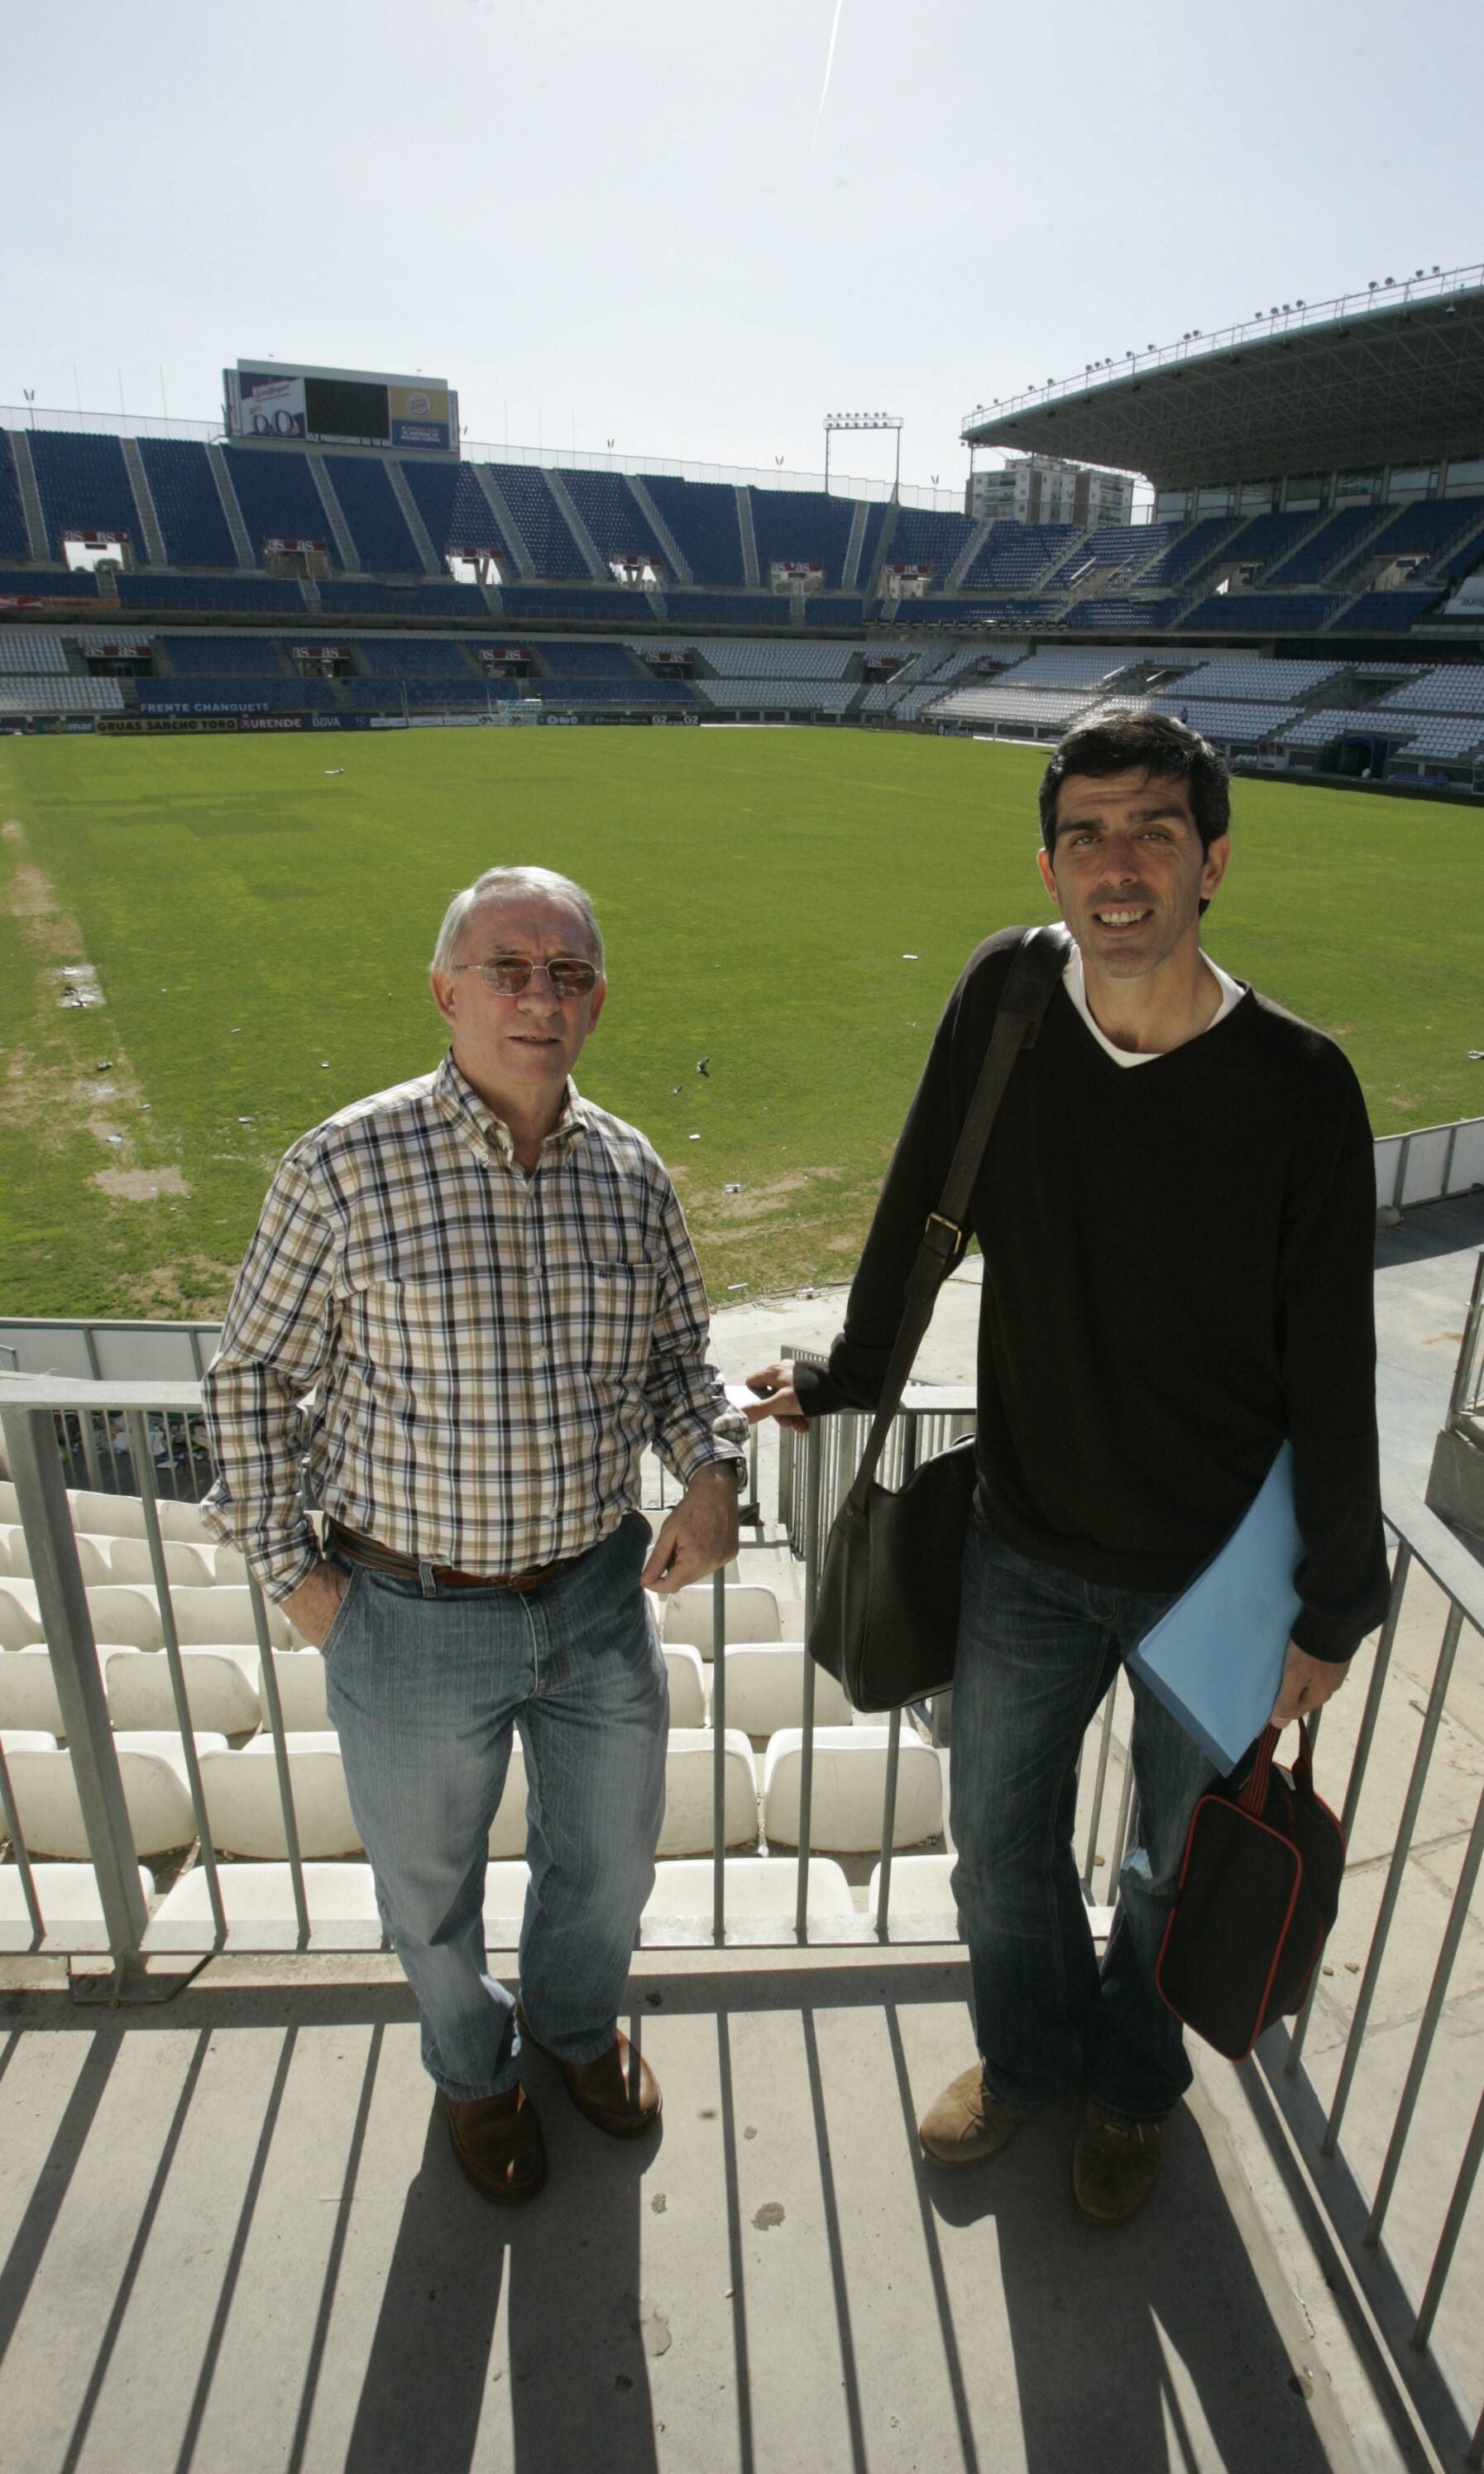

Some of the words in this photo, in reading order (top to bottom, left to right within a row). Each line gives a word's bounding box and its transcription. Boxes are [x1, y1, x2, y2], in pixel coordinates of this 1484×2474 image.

[450, 548, 464, 557] as
[476, 549, 491, 559] as
[85, 645, 105, 656] as
[119, 645, 137, 656] as
[292, 647, 309, 657] as
[322, 647, 339, 658] as
[479, 650, 494, 659] as
[505, 650, 521, 659] as
[868, 658, 882, 667] as
[141, 703, 190, 712] FRENTE
[194, 702, 270, 712] CHANQUETE
[251, 718, 302, 728] URENDE
[312, 717, 341, 726] BBVA
[652, 715, 667, 725] G2
[684, 715, 699, 725] G2
[97, 721, 142, 731] GRUAS
[146, 721, 198, 730] SANCHO
[201, 720, 236, 729] TORO
